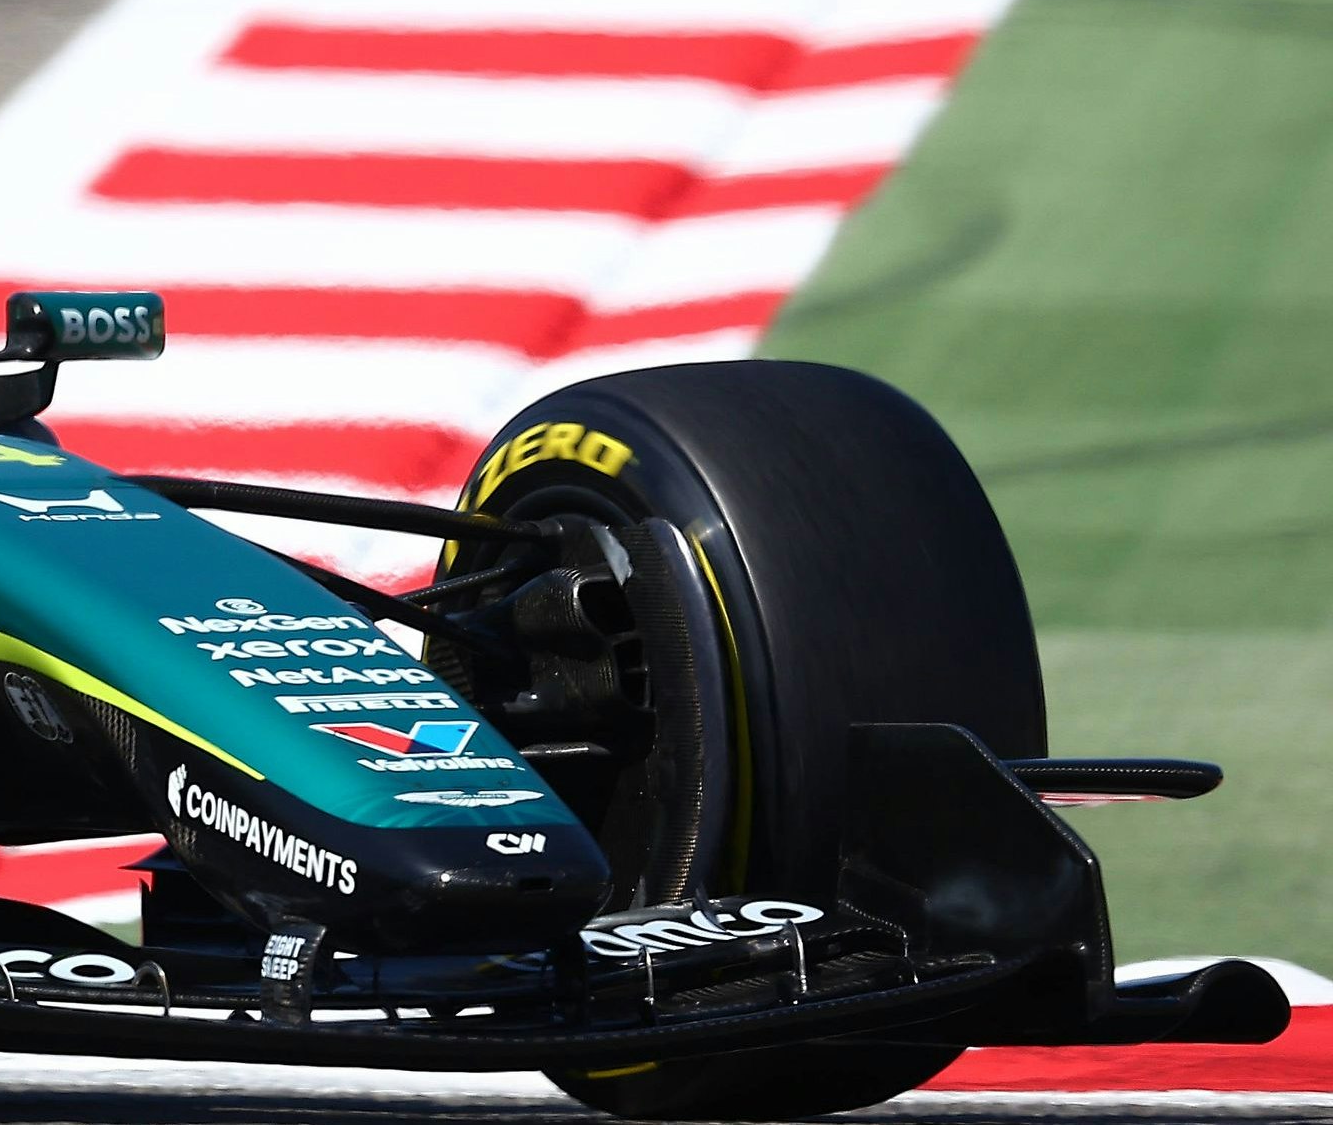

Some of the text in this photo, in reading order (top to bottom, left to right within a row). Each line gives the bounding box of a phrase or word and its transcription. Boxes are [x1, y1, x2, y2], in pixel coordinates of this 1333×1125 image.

[60, 306, 151, 344] BOSS
[474, 422, 635, 512] ZERO
[158, 613, 369, 635] NexGen
[196, 638, 404, 661] xerox
[229, 667, 435, 688] NetApp
[274, 691, 460, 713] PIRELLI
[185, 782, 358, 896] COINPAYMENTS
[579, 900, 825, 957] amco
[264, 934, 307, 958] EIGHT
